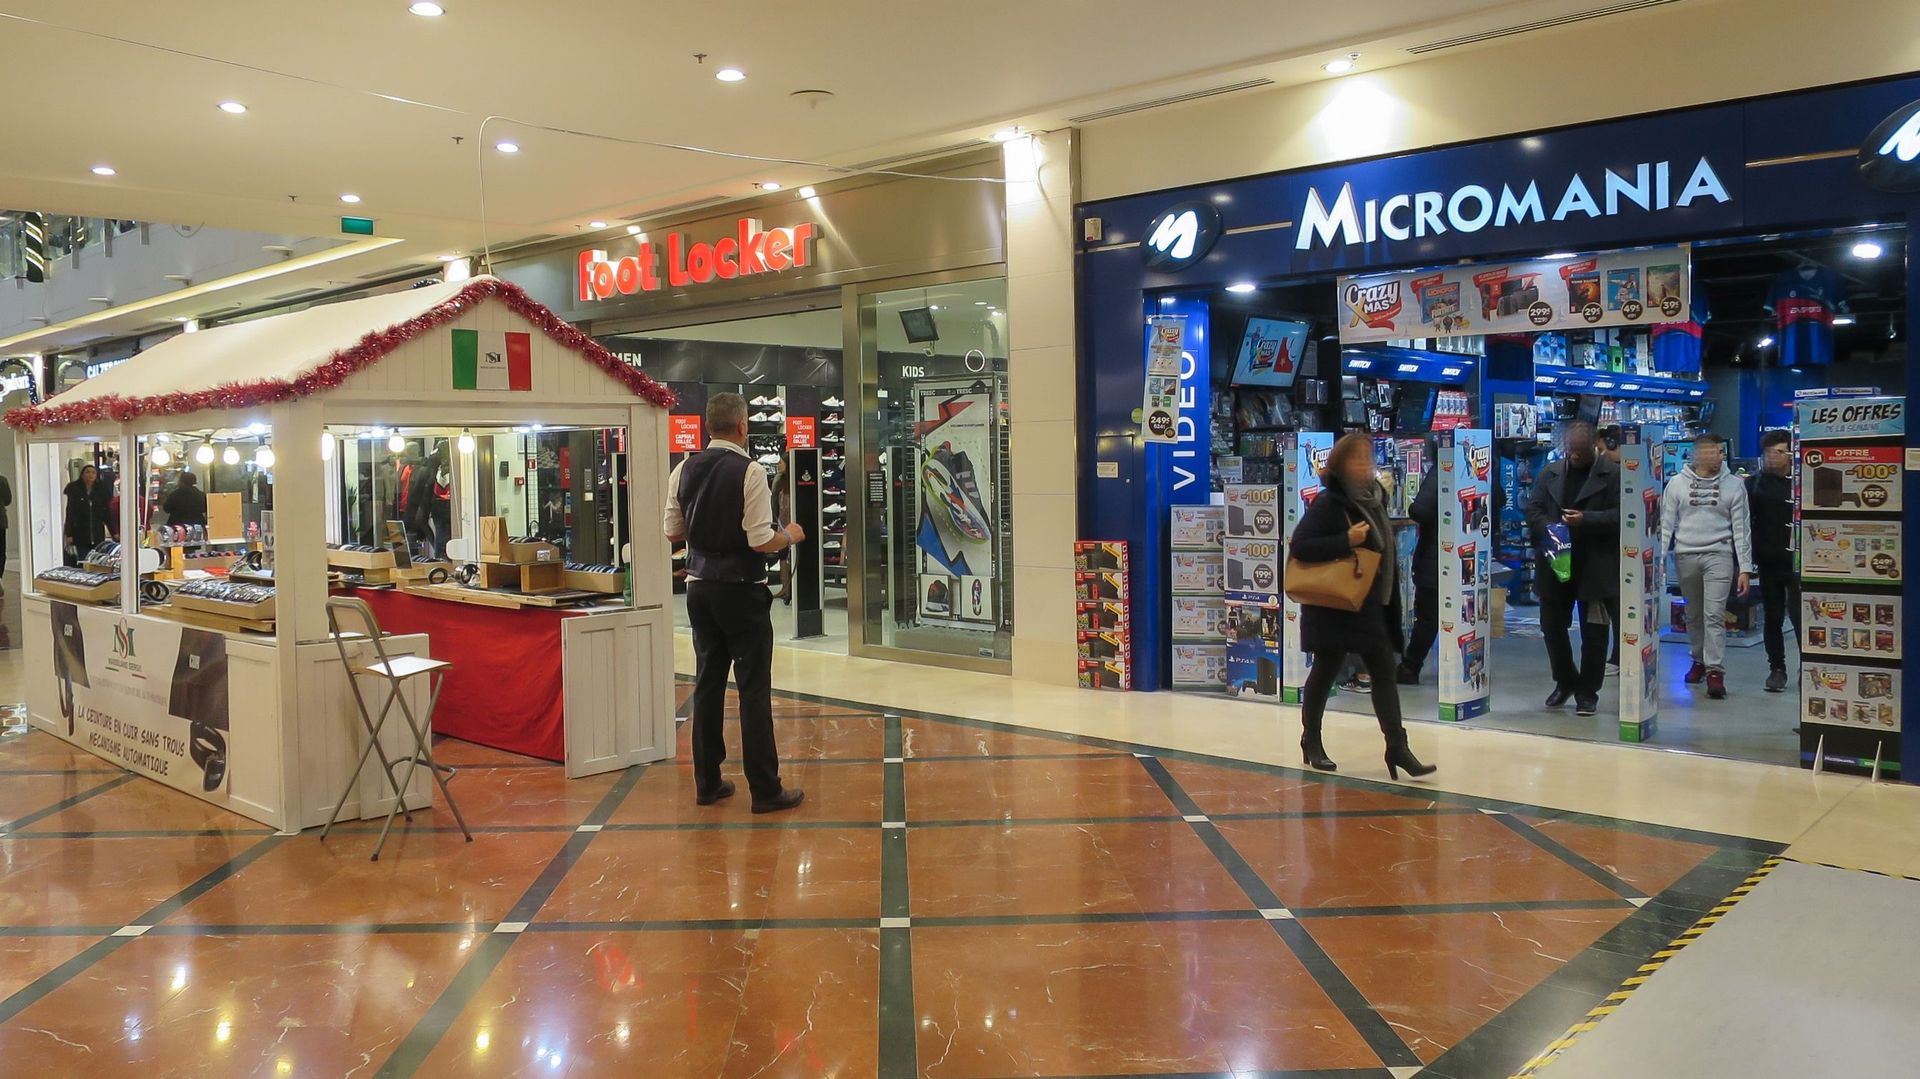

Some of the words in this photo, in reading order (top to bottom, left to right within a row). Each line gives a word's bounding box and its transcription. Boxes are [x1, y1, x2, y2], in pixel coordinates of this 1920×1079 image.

[667, 218, 813, 286] Locker
[1345, 281, 1399, 305] Crazy
[902, 366, 925, 377] KIDS
[1348, 359, 1371, 369] SWITCH
[1173, 351, 1195, 490] VIDEO
[1812, 408, 1838, 424] LES
[1842, 404, 1901, 422] OFFRES
[1807, 454, 1822, 464] ICI
[78, 704, 85, 718] LA
[113, 719, 121, 734] EN
[141, 729, 160, 748] SANS
[162, 735, 185, 757] TROUS
